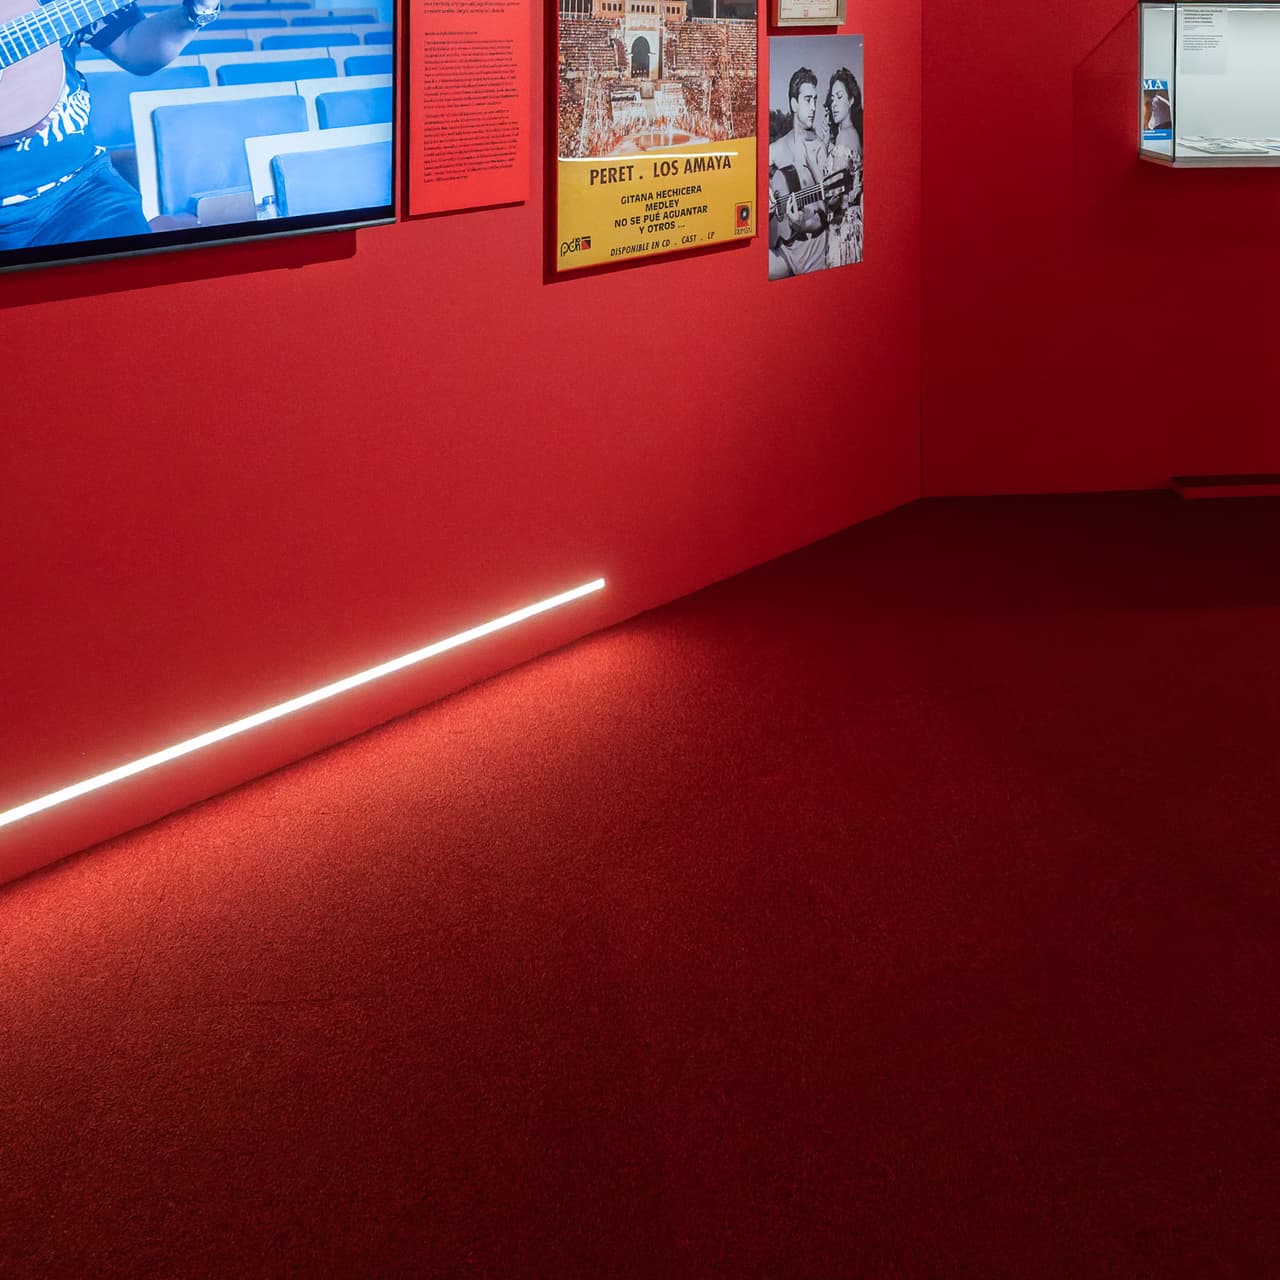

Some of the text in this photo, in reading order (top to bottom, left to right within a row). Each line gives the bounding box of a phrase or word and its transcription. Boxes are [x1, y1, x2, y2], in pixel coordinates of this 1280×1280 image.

[590, 155, 731, 186] PERET LOS AMAYA
[621, 185, 702, 205] GITANA HECHICERA
[645, 199, 679, 212] MEDLEY
[614, 218, 627, 228] NO
[630, 216, 640, 225] SE
[663, 205, 708, 220] AGUANTAR
[647, 221, 676, 233] OTROS
[610, 242, 650, 257] DISPONIBLE
[652, 240, 660, 250] EN
[662, 239, 670, 248] CD
[682, 234, 697, 245] CAST
